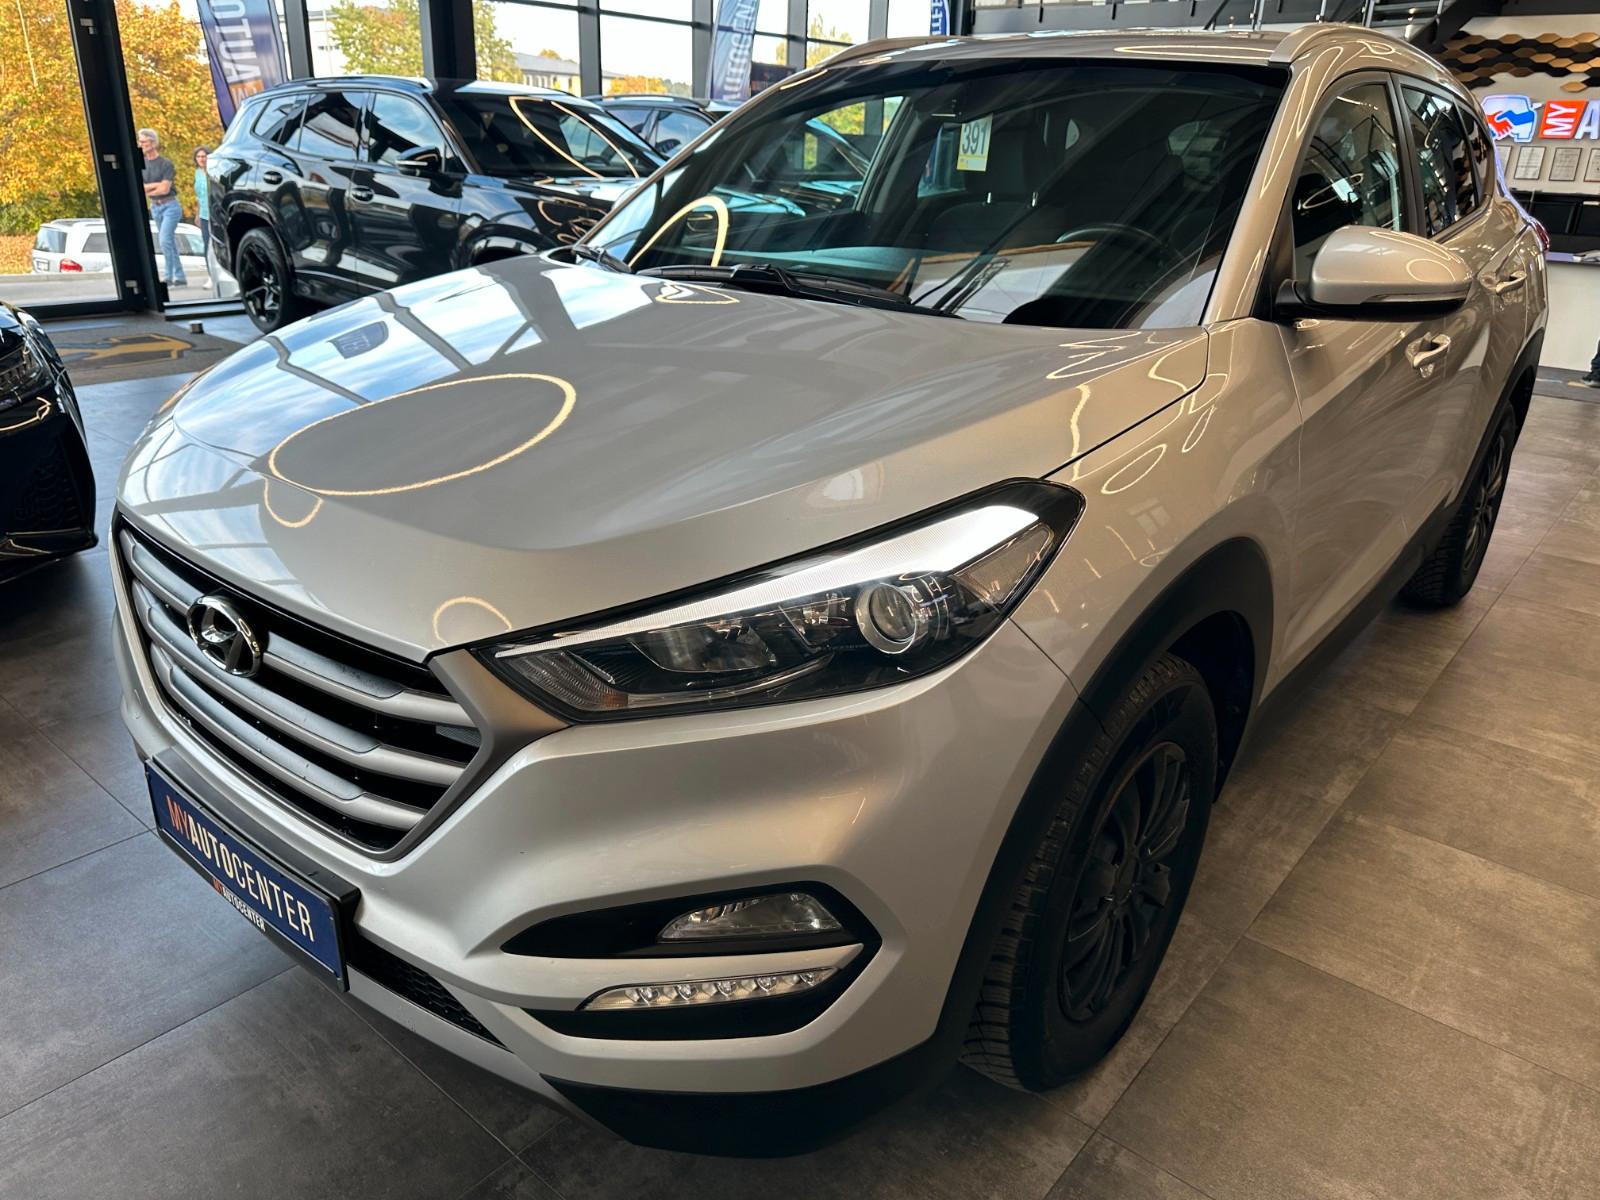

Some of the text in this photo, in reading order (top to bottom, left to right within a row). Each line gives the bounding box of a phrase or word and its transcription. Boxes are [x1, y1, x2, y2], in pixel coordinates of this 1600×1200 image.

[1543, 103, 1577, 136] MY
[962, 121, 988, 155] 391
[166, 795, 315, 943] MYAUTOCENTER
